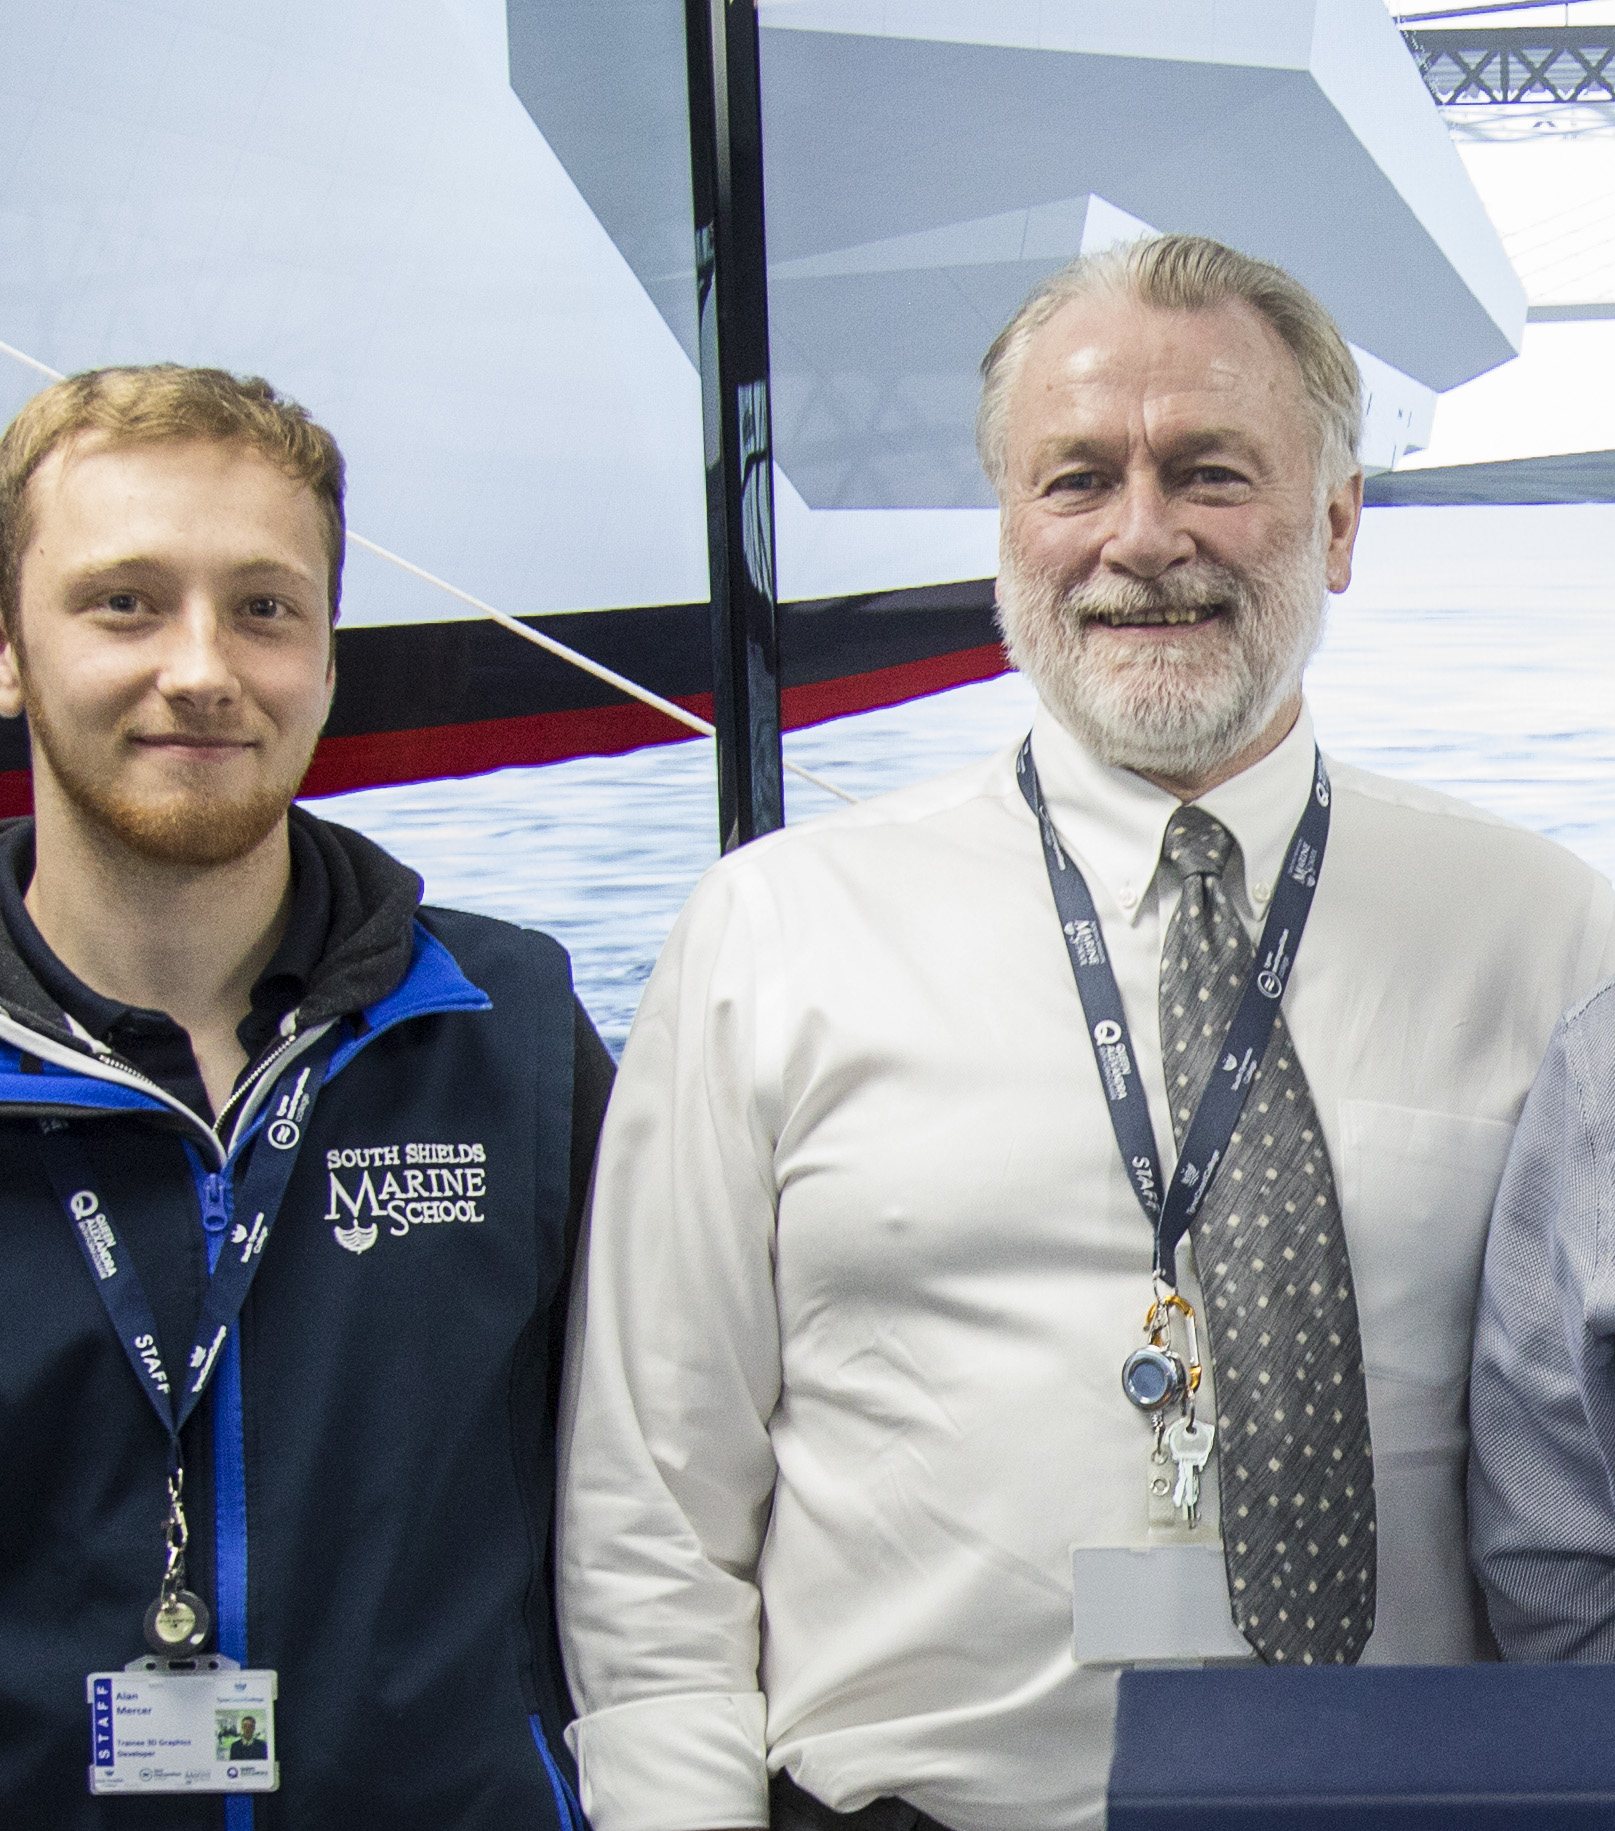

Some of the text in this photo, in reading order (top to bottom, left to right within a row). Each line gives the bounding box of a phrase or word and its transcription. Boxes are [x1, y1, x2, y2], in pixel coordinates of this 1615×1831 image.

[326, 1142, 487, 1170] SOUTH SHIELDS
[323, 1167, 487, 1220] MARINE
[1132, 1155, 1161, 1213] STAFF
[387, 1199, 485, 1237] SCHOOL
[134, 1334, 171, 1394] STAFF
[96, 1684, 111, 1760] STAFF
